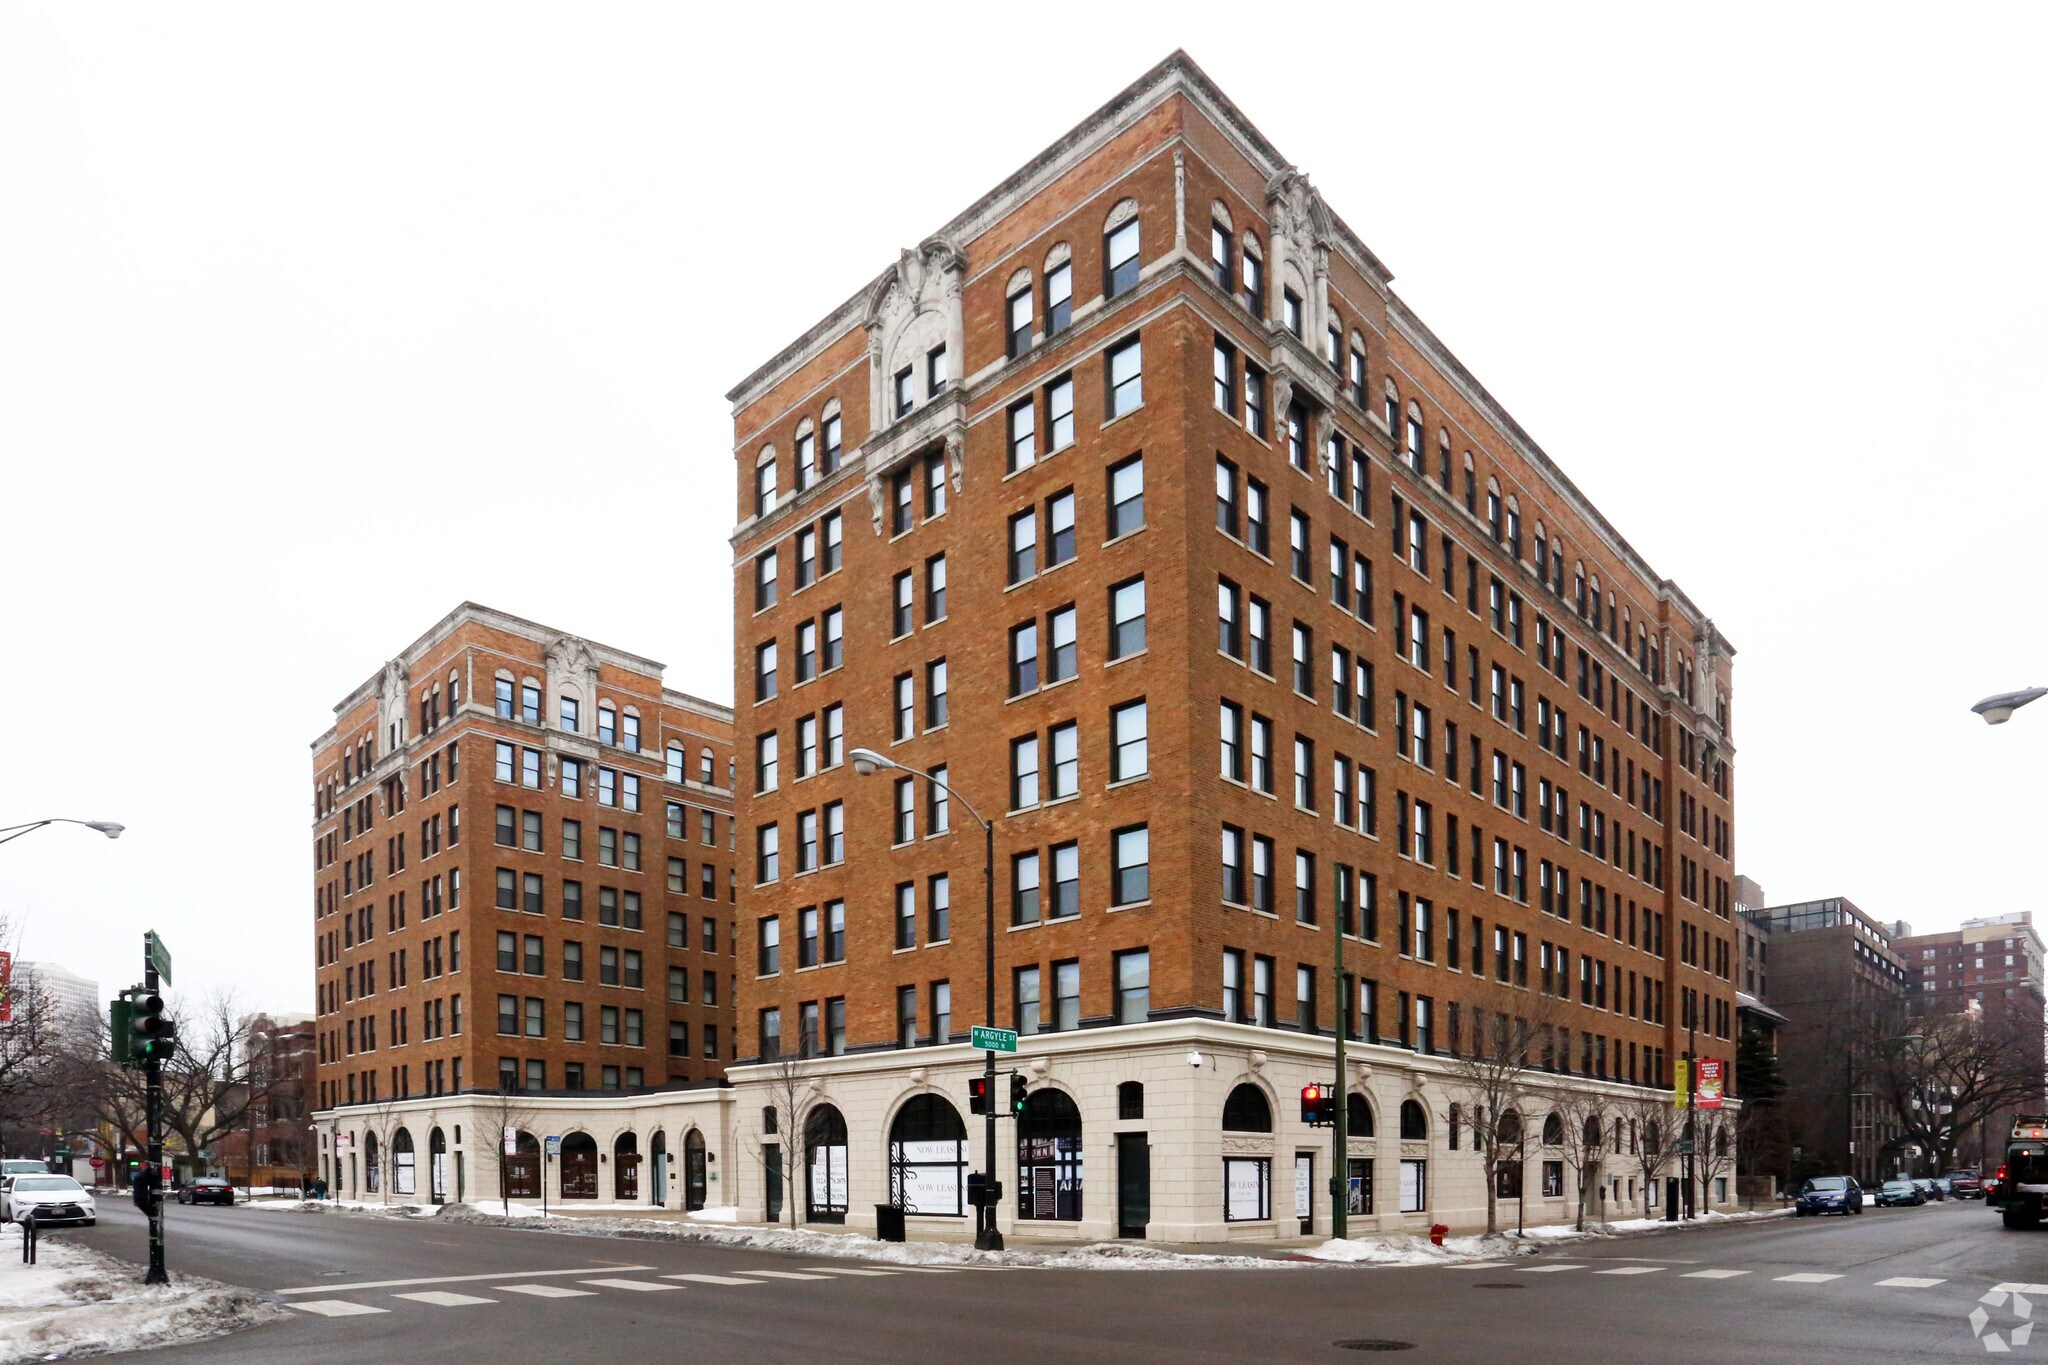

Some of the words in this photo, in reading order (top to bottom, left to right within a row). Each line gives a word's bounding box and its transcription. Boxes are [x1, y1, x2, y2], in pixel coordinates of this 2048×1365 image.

[980, 1030, 1007, 1042] ARGYLE
[984, 1040, 999, 1049] 5000
[917, 1146, 933, 1154] NOW
[918, 1184, 934, 1192] NOW
